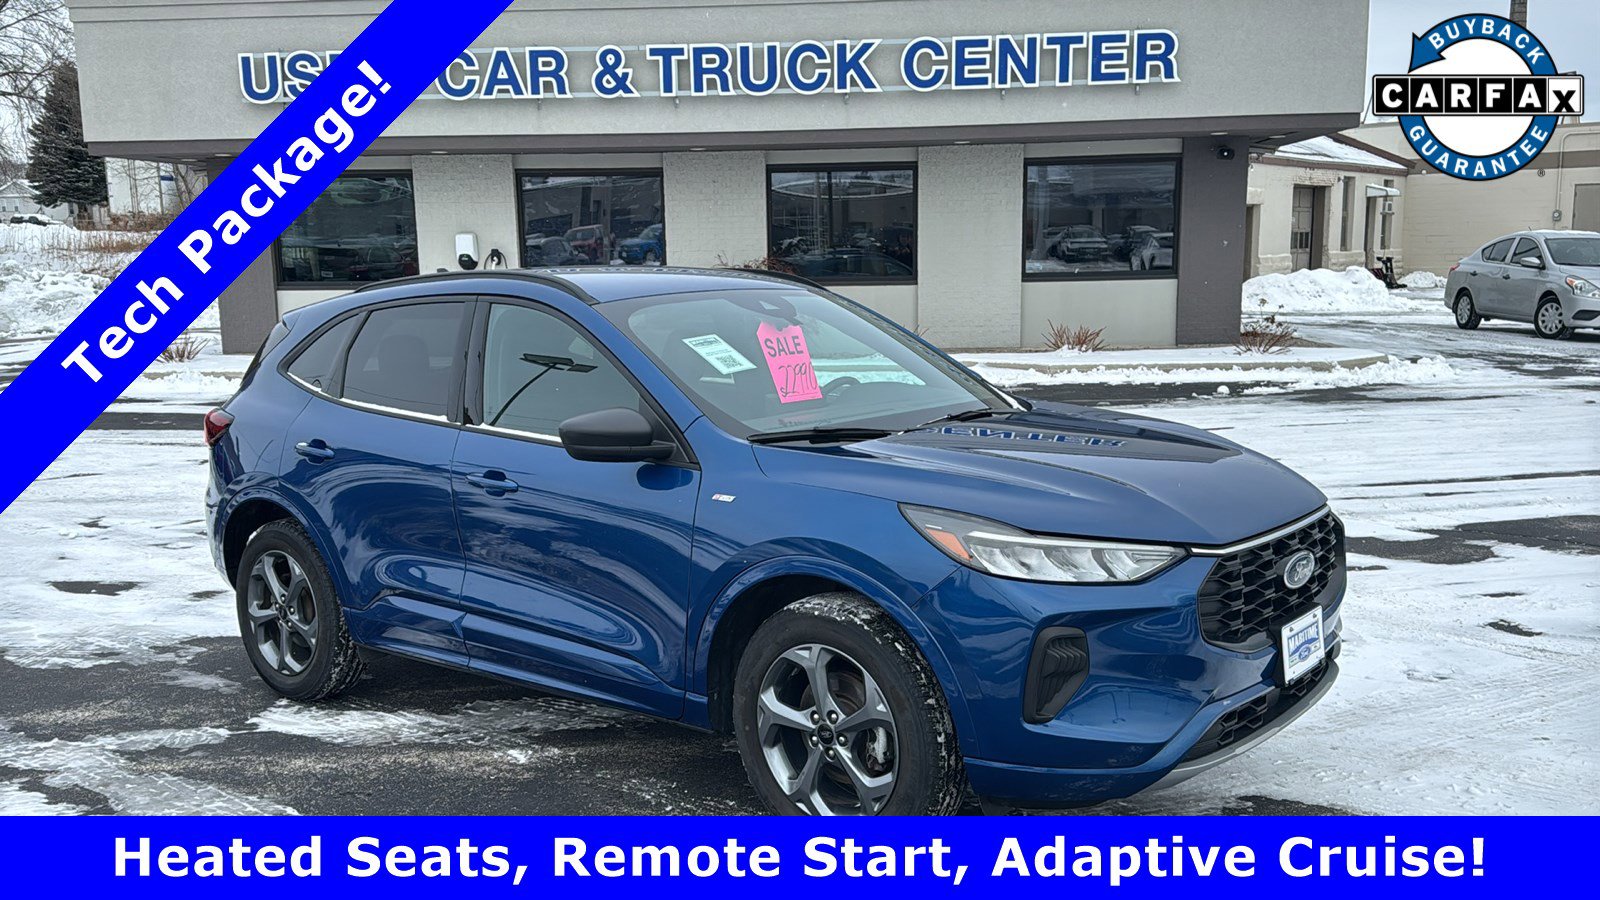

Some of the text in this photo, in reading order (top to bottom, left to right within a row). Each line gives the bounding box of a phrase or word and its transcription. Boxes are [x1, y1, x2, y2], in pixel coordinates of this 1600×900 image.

[237, 28, 1181, 104] US CAR & TRUCK CENTER
[764, 335, 804, 358] SALE
[1288, 623, 1319, 655] MARITIME
